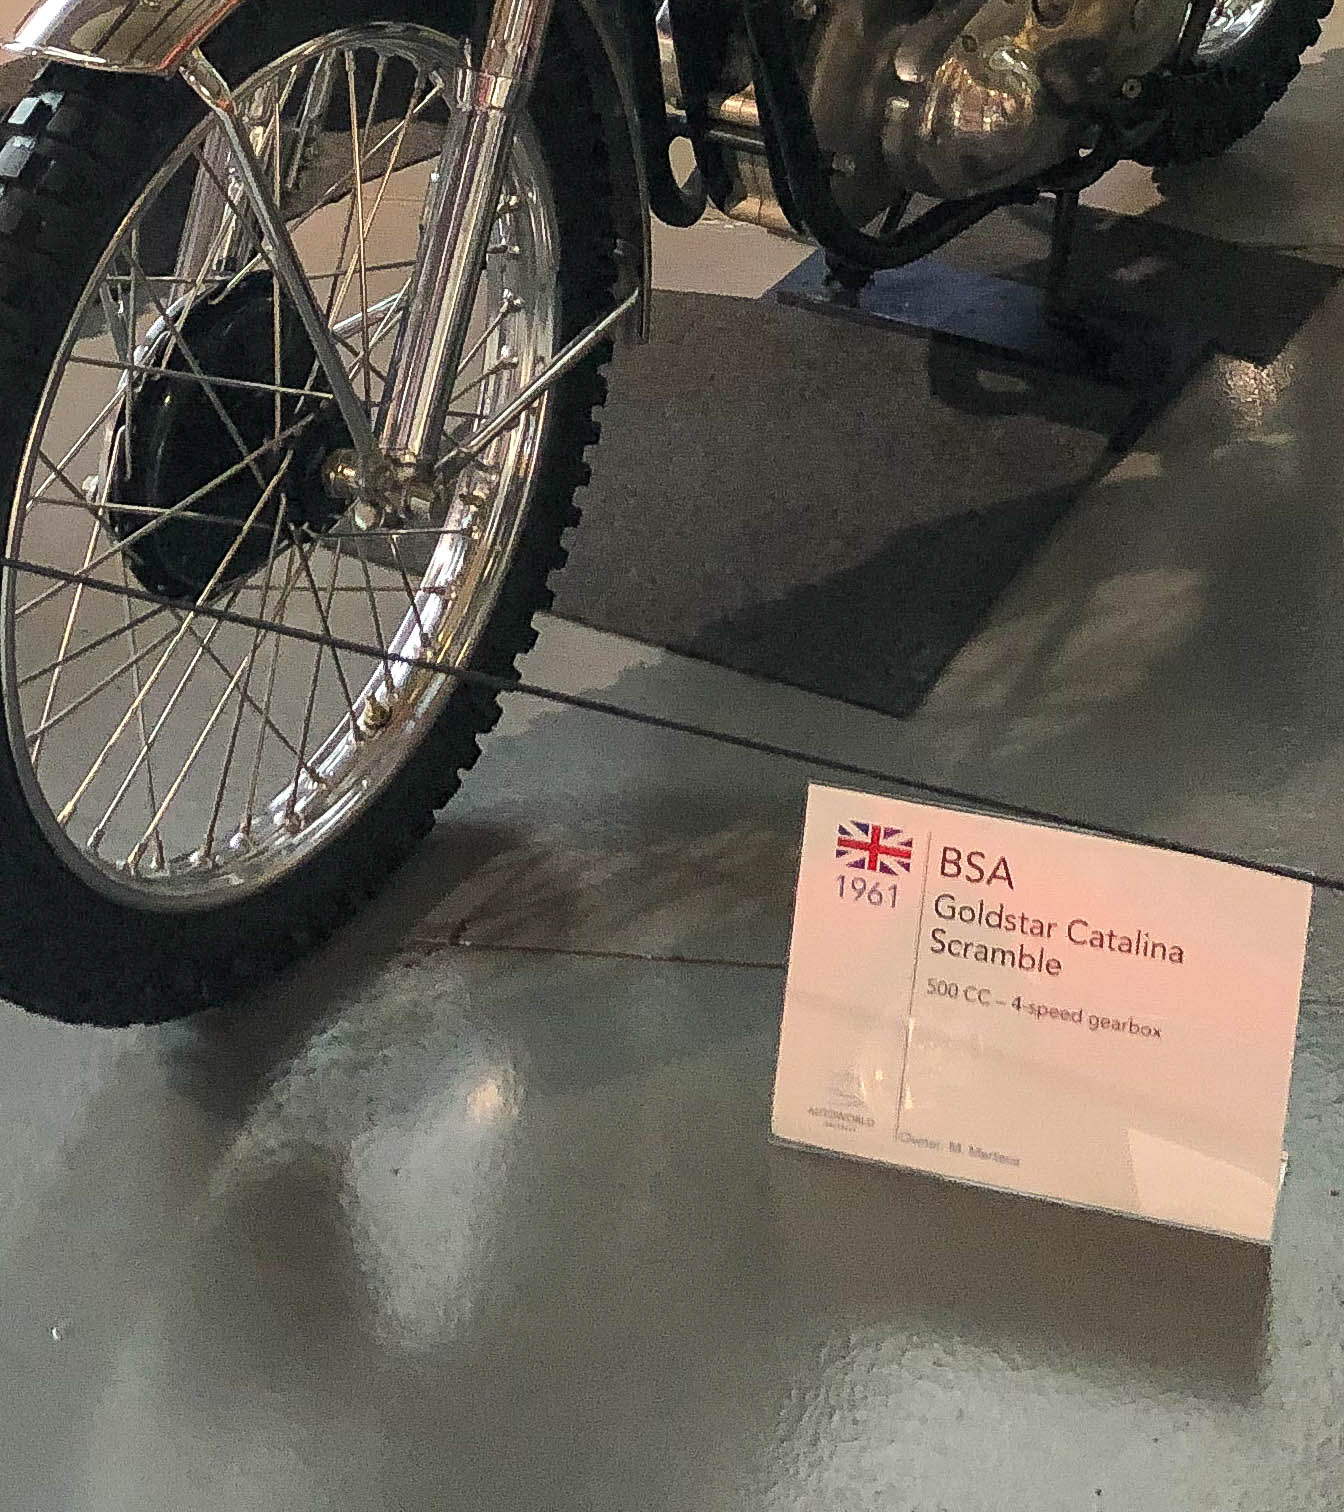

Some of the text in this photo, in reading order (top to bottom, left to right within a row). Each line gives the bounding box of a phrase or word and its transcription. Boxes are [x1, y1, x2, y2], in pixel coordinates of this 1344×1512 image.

[835, 874, 898, 908] 1961
[940, 845, 1014, 890] BSA
[930, 928, 1063, 976] Scramble
[934, 893, 1185, 964] Goldstar Catalina
[927, 977, 959, 999] 500
[963, 985, 991, 1006] CC
[1011, 995, 1083, 1021] 4-speed
[1088, 1013, 1163, 1039] gearbox
